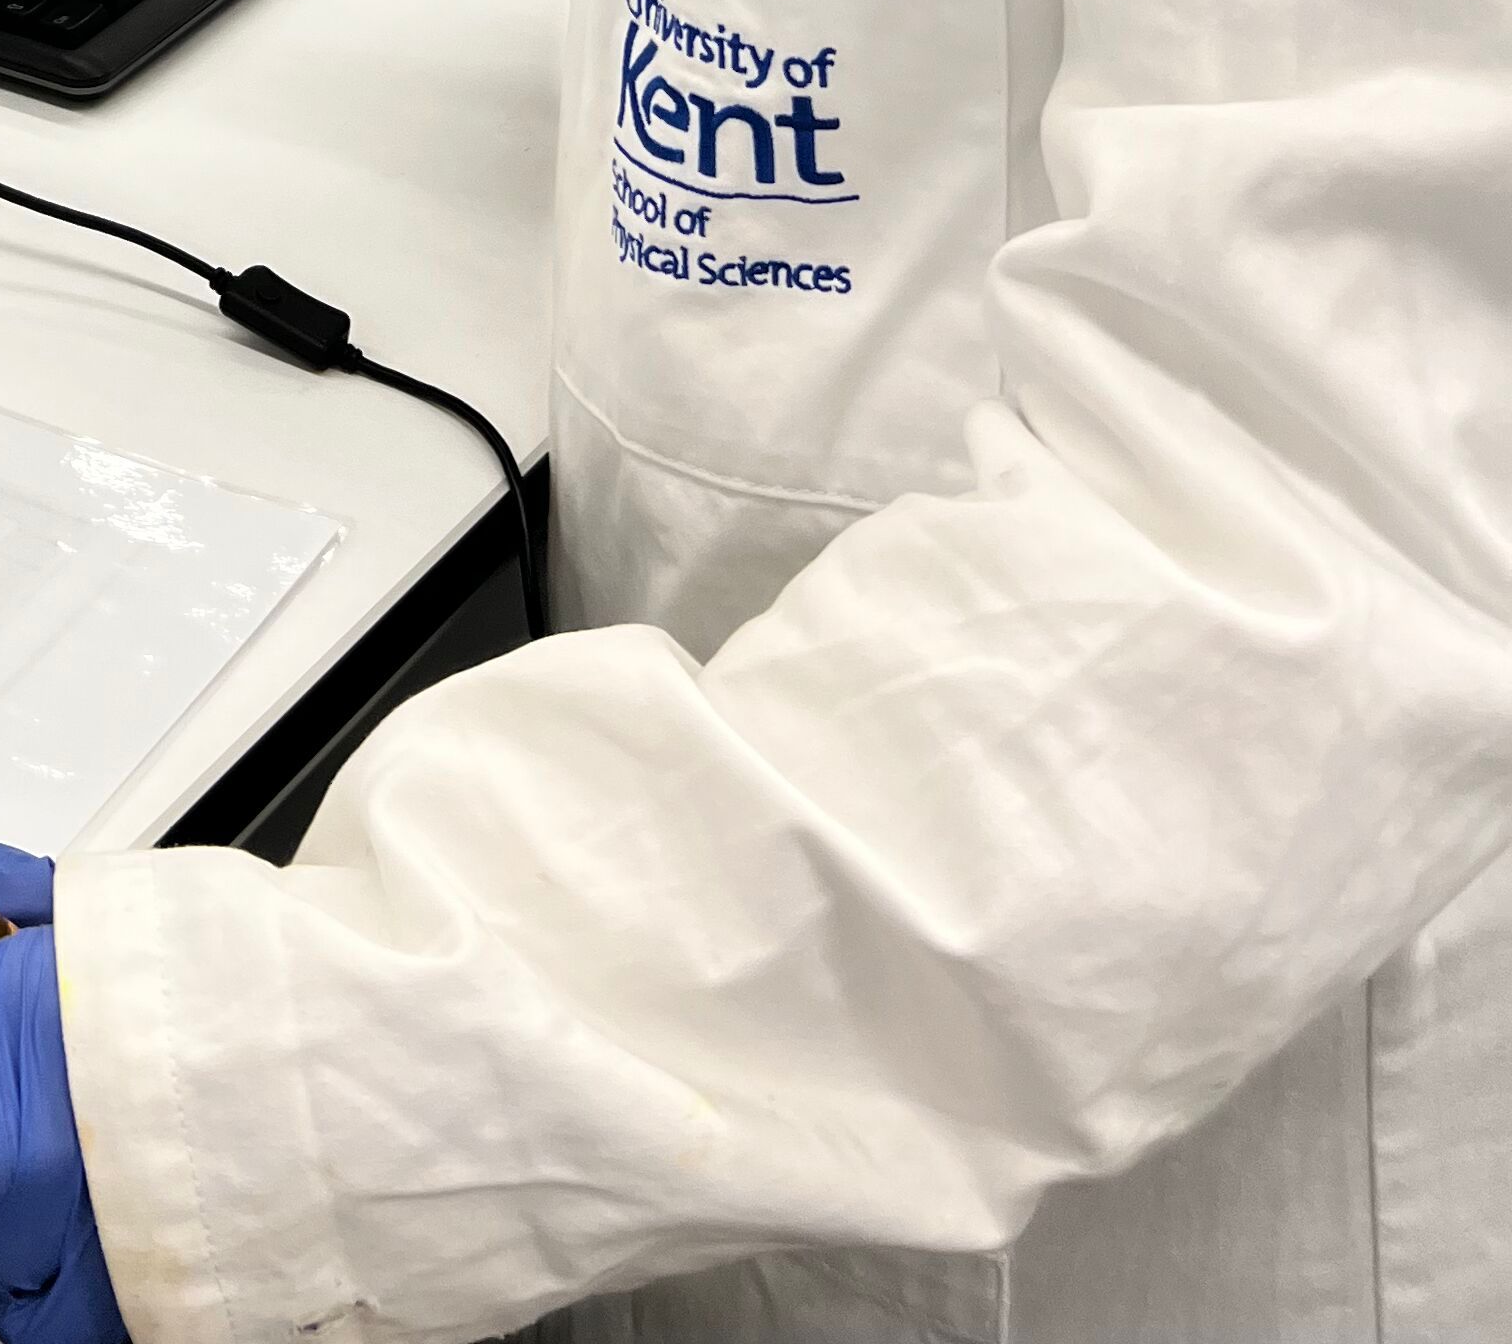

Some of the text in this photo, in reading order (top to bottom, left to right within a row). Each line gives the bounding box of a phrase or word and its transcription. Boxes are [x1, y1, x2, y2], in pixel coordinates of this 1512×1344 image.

[782, 47, 837, 89] of
[618, 20, 845, 185] Kent
[674, 206, 712, 237] of
[697, 253, 852, 294] Sciences
